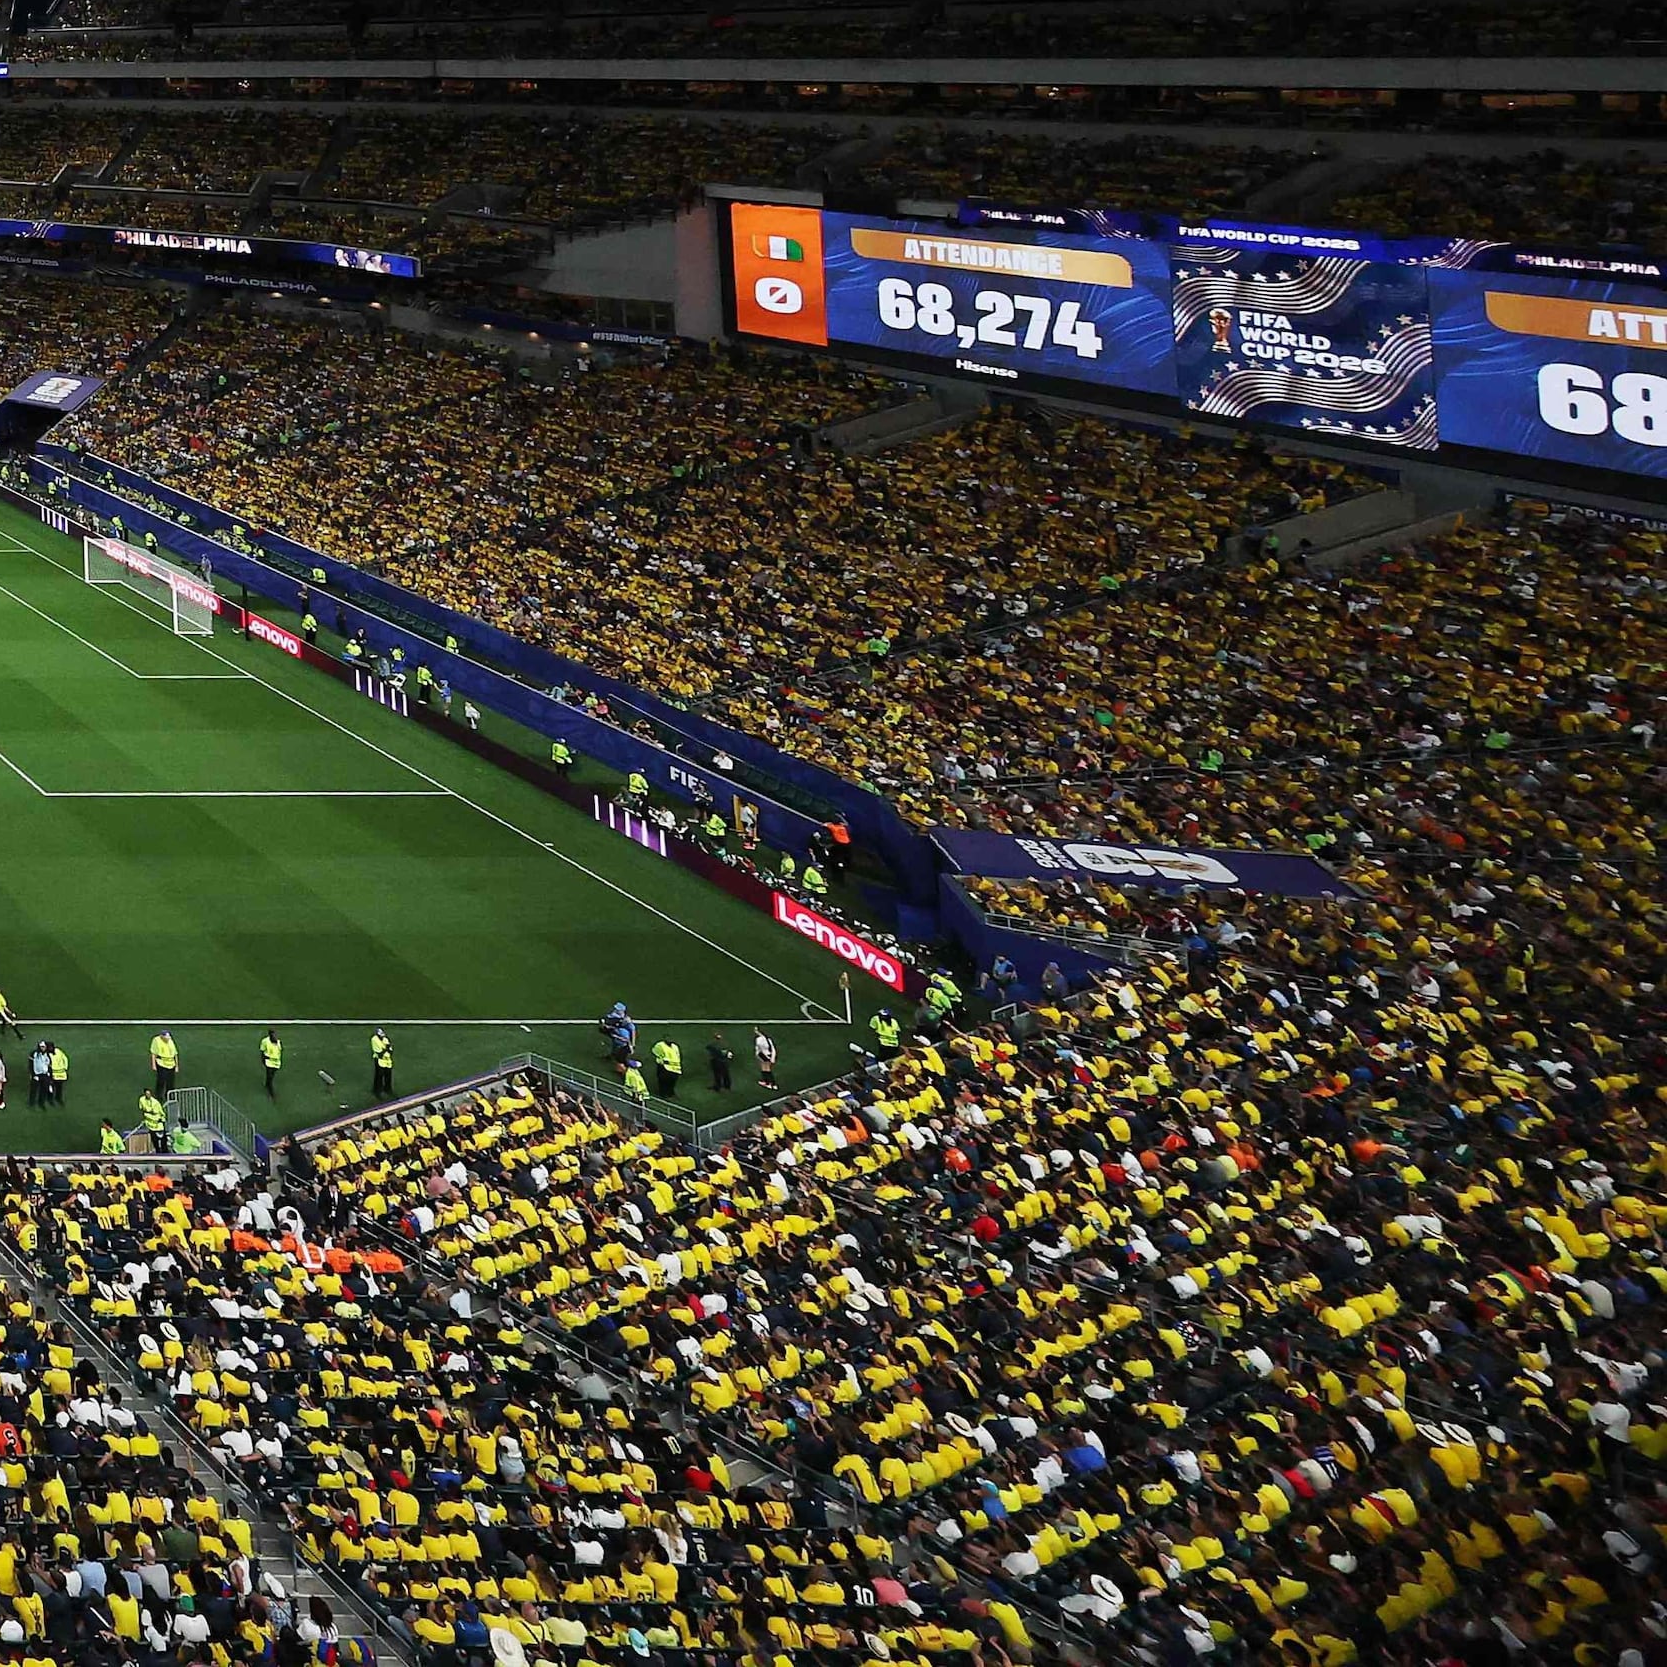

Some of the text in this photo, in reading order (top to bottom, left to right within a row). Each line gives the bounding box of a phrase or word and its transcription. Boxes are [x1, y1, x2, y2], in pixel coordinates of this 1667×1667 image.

[980, 209, 1065, 226] PHILADLPHIA
[114, 230, 253, 255] PHILADELPHIA
[1179, 226, 1361, 252] FIFA WORLD CUP 2026
[904, 237, 1065, 276] ATTENDANCE
[1516, 253, 1661, 276] PHILADELPHIA
[205, 274, 318, 293] PHILADELPHIA
[754, 276, 803, 315] 0
[877, 277, 1104, 360] 68,274
[1238, 309, 1292, 331] FIFA
[1238, 325, 1331, 352] WORLD
[955, 358, 1019, 380] Hisense
[1240, 343, 1389, 376] CUP 2026
[249, 619, 299, 655] enovo
[669, 765, 706, 792] FIF
[1015, 838, 1060, 872] 2026
[778, 895, 897, 985] Lenovo
[29, 1233, 36, 1245] 9
[663, 1436, 682, 1455] 10
[853, 1585, 875, 1606] 10
